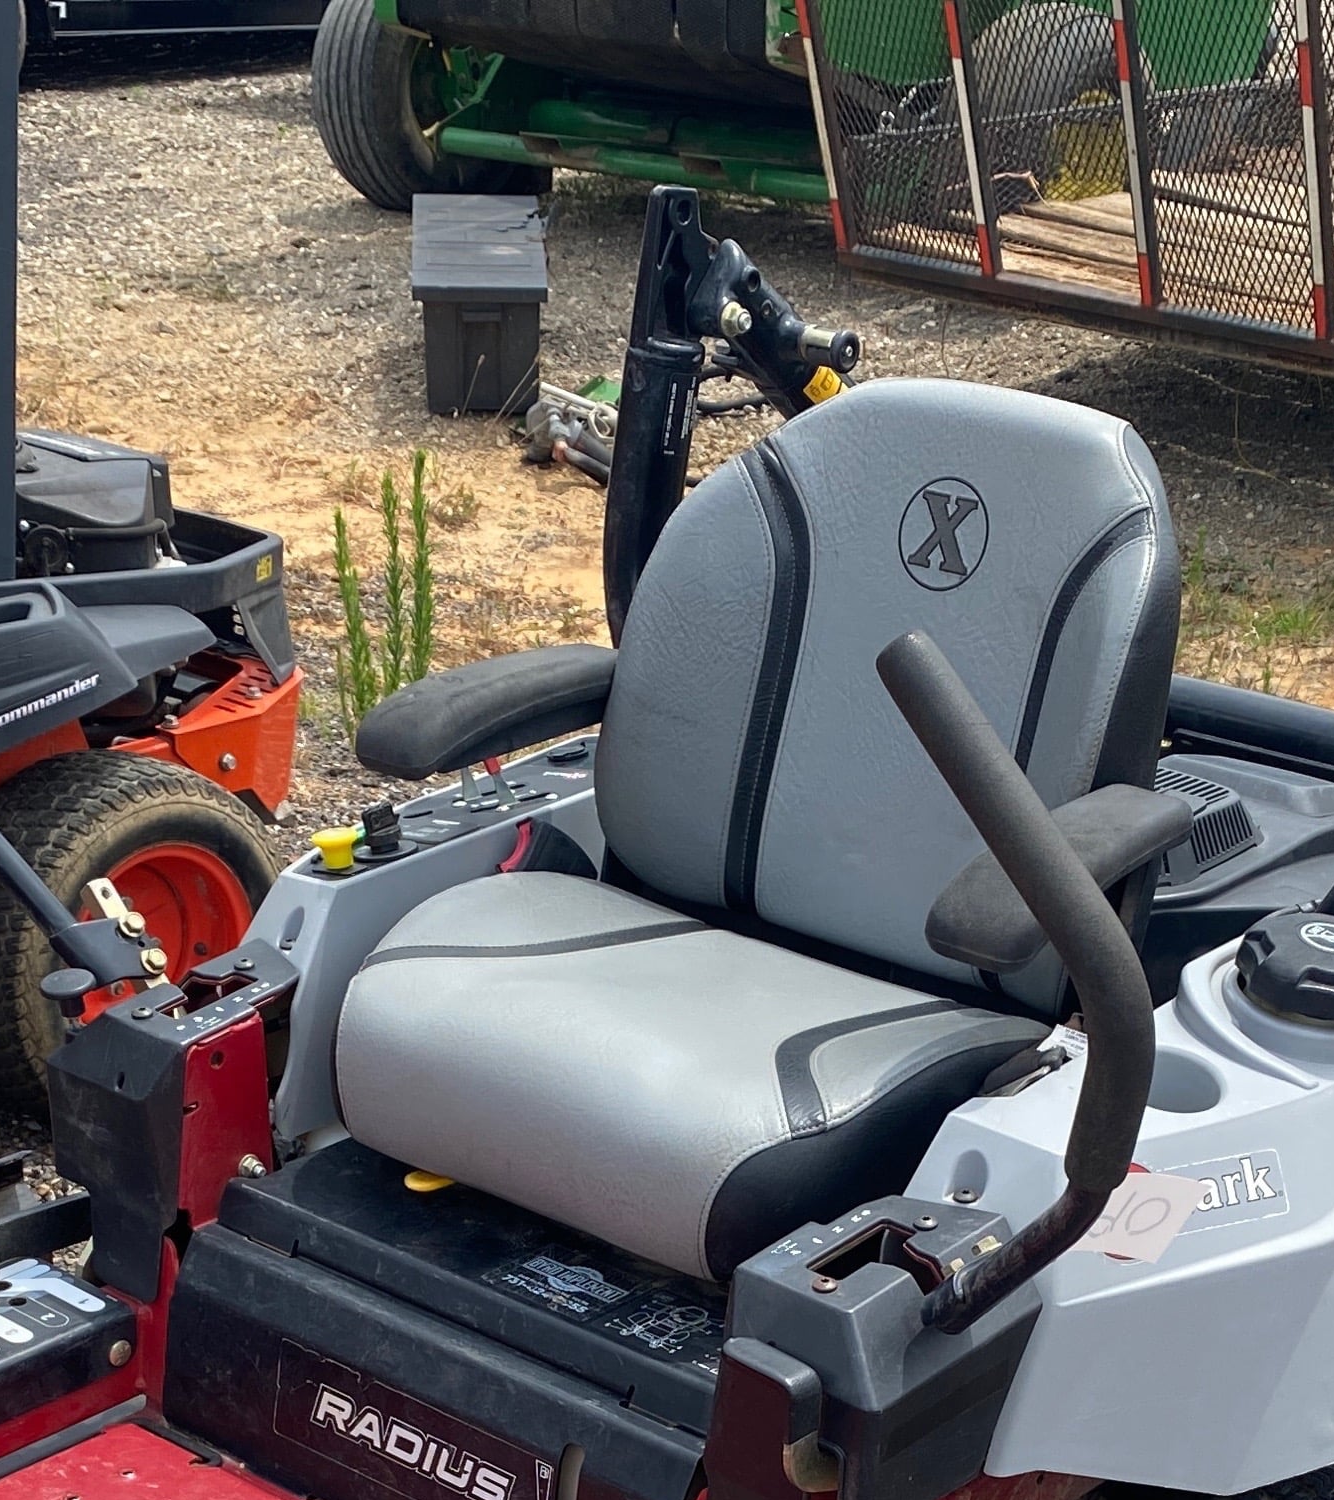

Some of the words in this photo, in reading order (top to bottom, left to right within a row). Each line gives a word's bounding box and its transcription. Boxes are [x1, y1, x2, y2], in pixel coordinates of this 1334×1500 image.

[1189, 1156, 1278, 1213] ark
[530, 1257, 562, 1276] BYRD
[560, 1269, 622, 1302] IMPLEMENT
